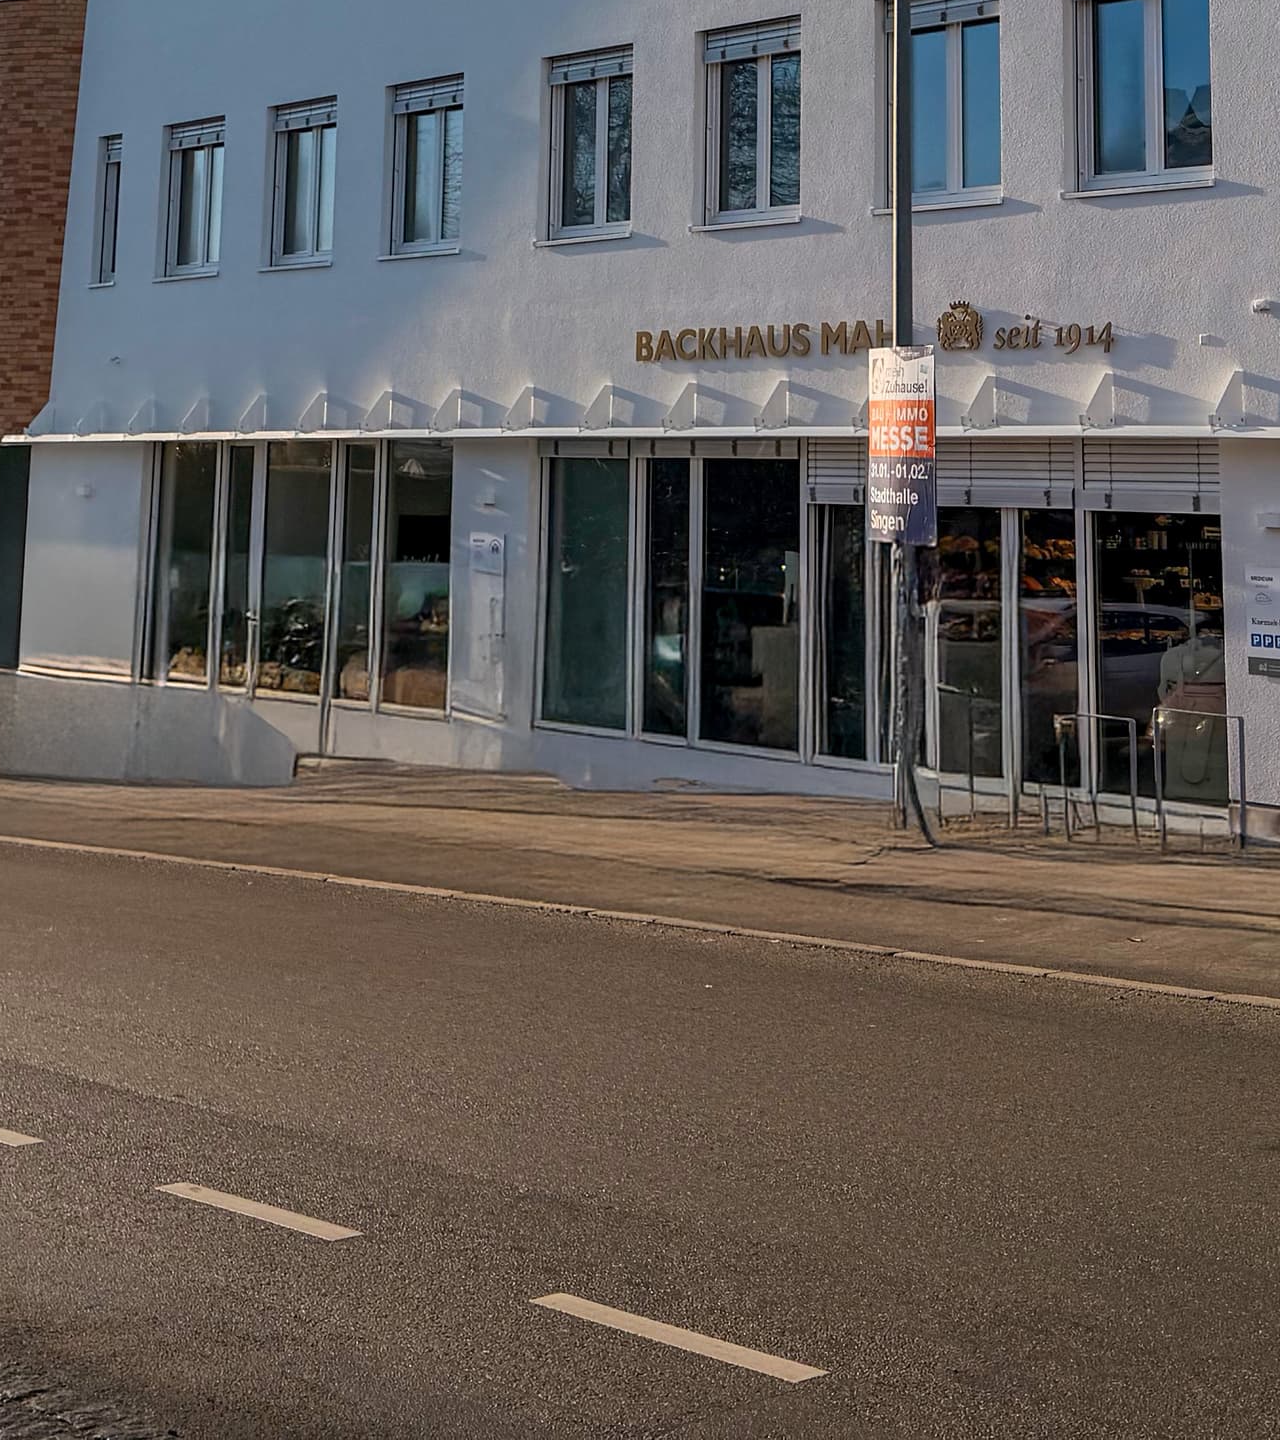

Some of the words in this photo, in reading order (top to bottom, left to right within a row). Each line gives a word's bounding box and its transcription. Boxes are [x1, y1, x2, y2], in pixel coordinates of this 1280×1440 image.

[636, 323, 811, 361] BACKHAUS
[821, 319, 894, 356] MAH
[992, 313, 1042, 350] seit
[1054, 321, 1115, 355] 1914
[885, 379, 928, 394] Zuhause!
[871, 425, 928, 451] MESSE
[870, 486, 919, 505] Stadthalle
[870, 509, 904, 534] Singen
